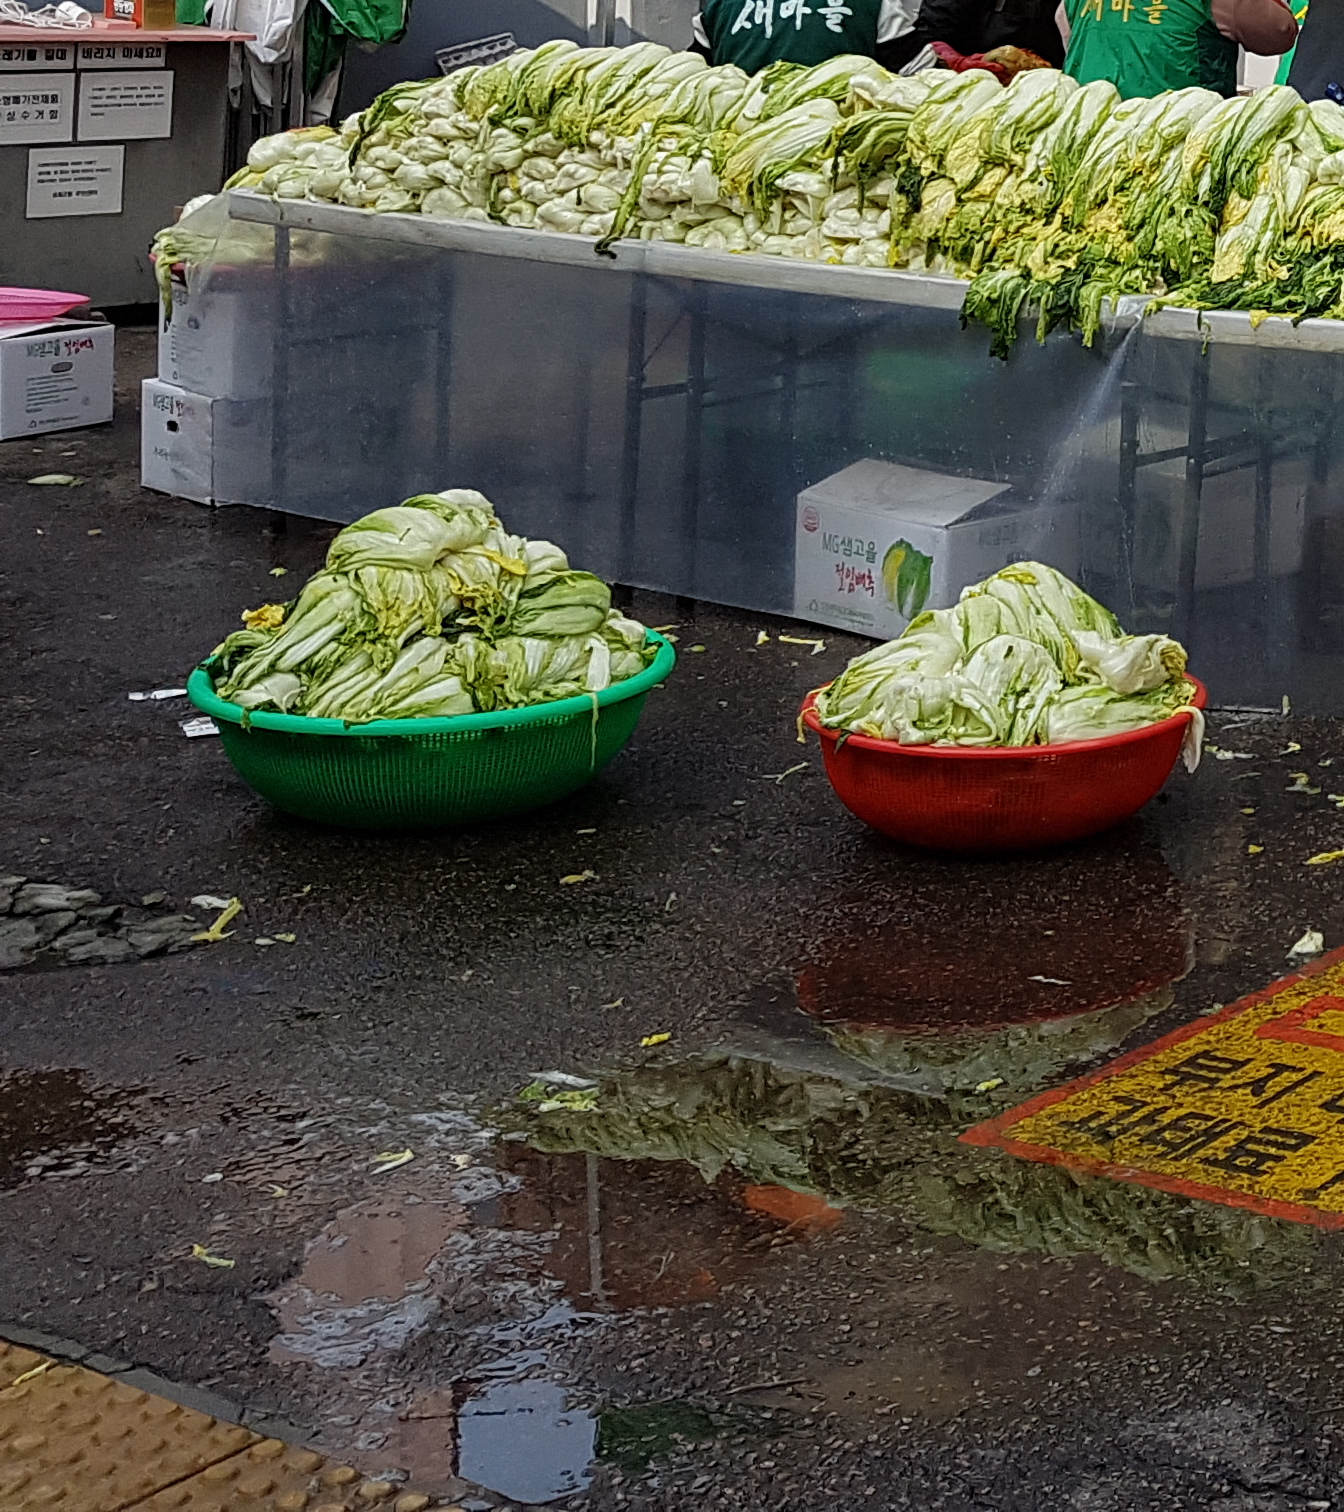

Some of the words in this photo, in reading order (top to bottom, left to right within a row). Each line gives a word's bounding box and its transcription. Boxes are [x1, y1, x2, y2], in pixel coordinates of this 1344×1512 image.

[0, 48, 37, 62] 레기를
[1157, 1049, 1326, 1109] 부지
[1057, 1094, 1317, 1177] 과태료
